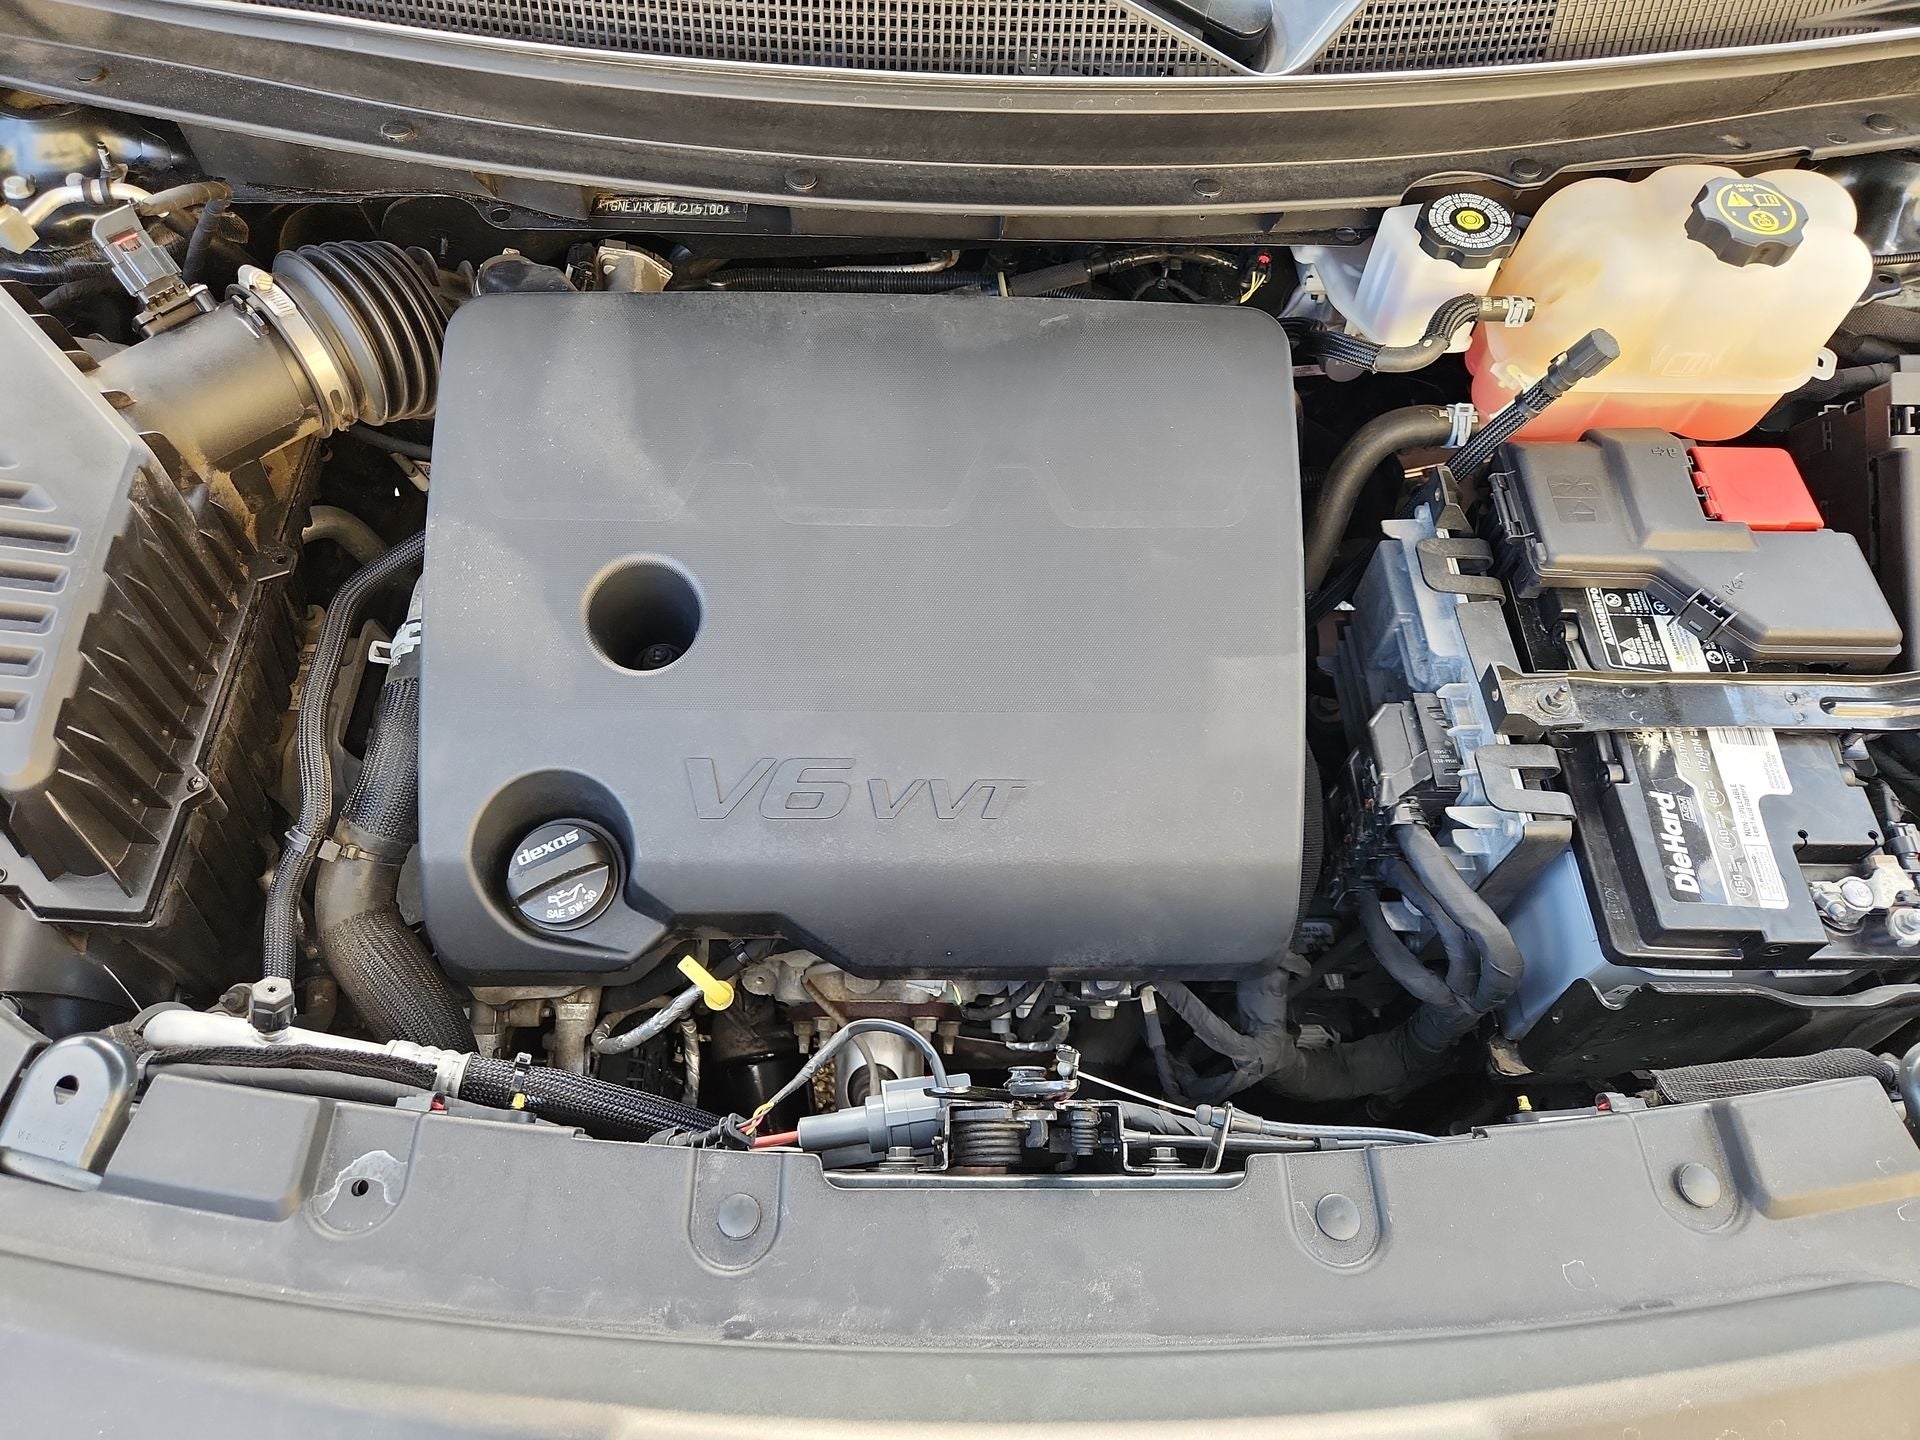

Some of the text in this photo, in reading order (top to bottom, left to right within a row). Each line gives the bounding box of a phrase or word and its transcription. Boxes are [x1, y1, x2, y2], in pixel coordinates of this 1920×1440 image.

[1676, 729, 1690, 768] PLATINU
[684, 757, 1034, 820] V6 VVT
[1707, 790, 1719, 802] 80
[1678, 797, 1692, 818] AGM
[517, 828, 579, 866] dexos
[1648, 790, 1701, 893] DieHard
[1732, 874, 1746, 893] 850
[546, 889, 597, 918] SAE 5W-30
